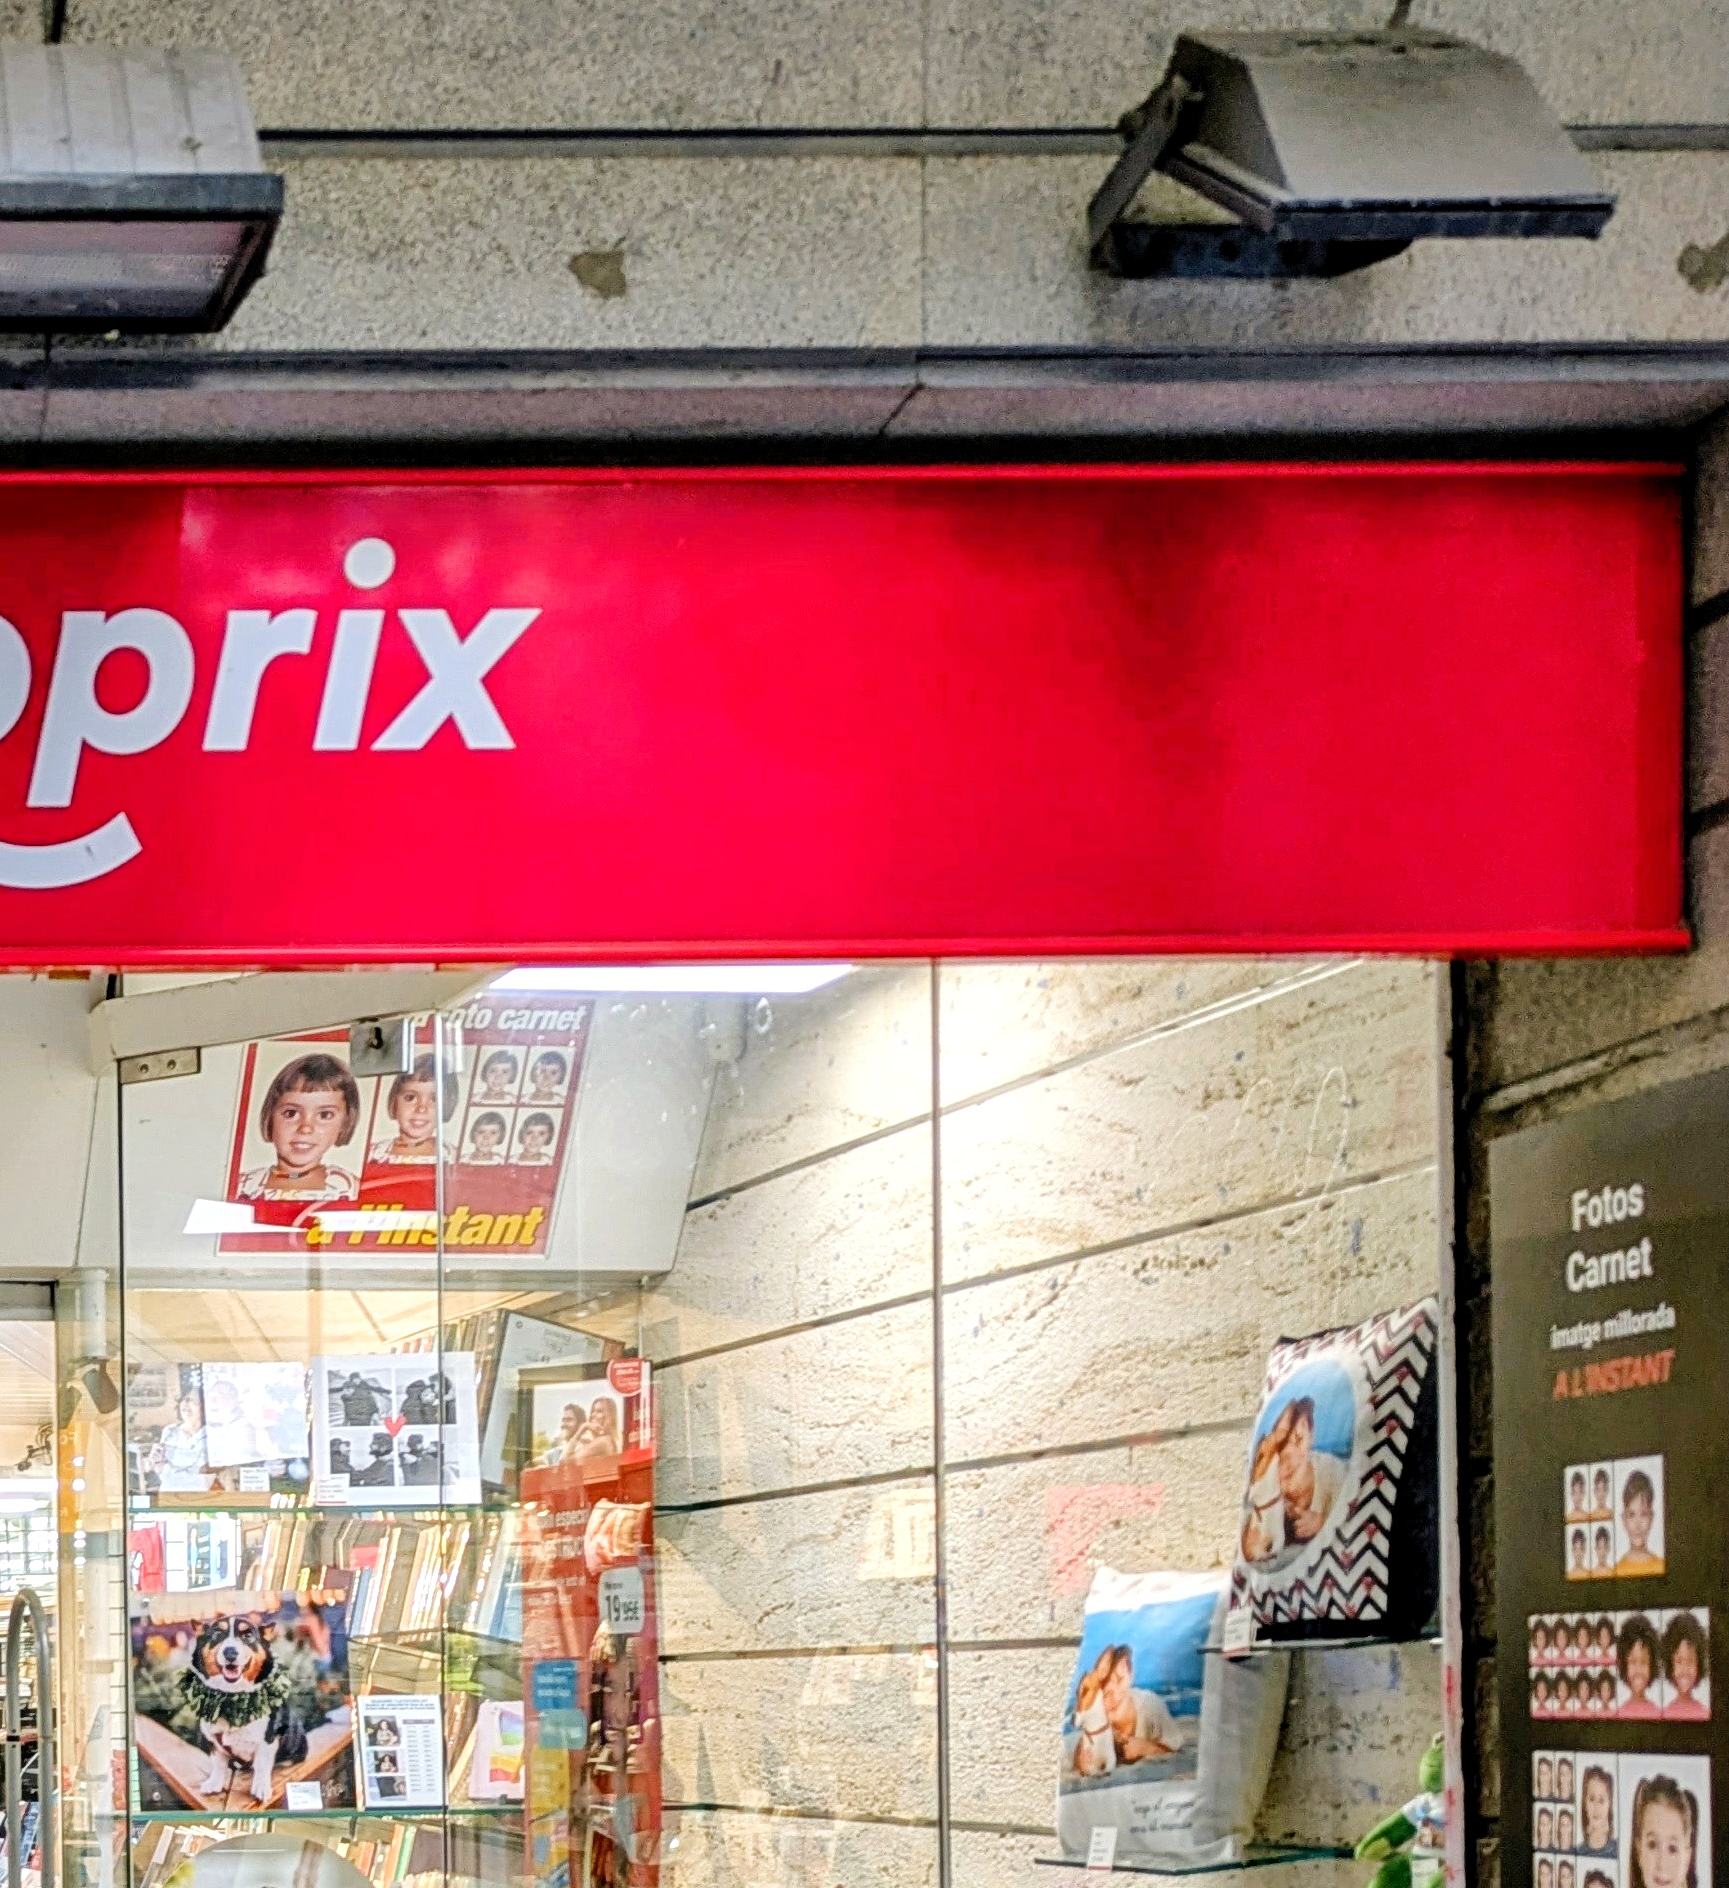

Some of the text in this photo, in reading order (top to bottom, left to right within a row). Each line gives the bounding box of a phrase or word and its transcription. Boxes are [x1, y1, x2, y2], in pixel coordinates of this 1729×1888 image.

[496, 1005, 587, 1031] carnet
[1571, 1179, 1645, 1231] Fotos
[1565, 1237, 1653, 1293] Carnet
